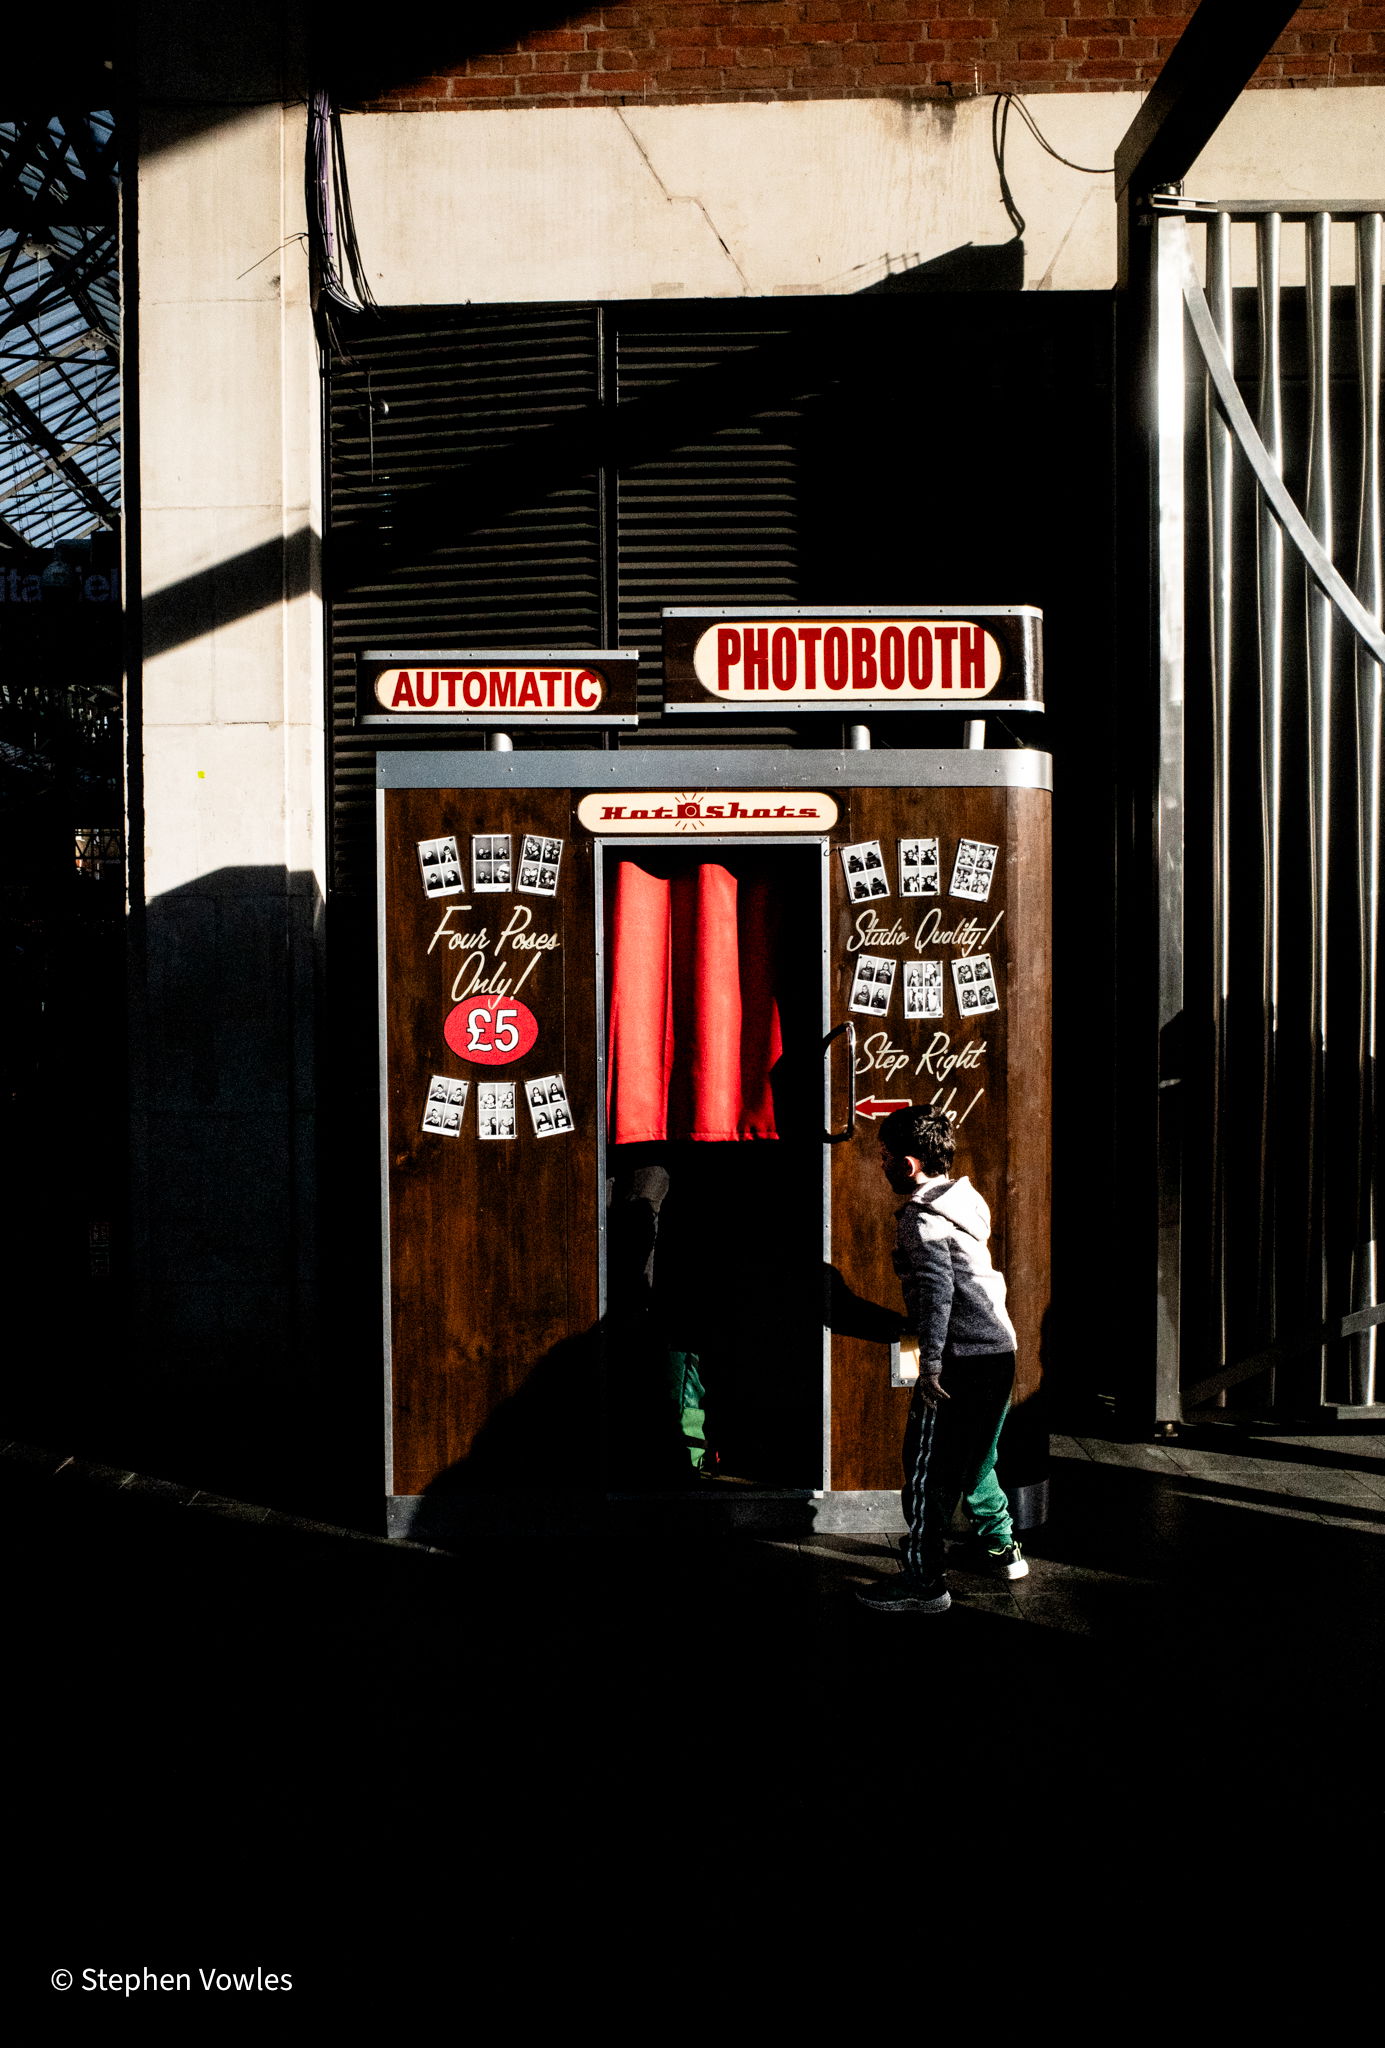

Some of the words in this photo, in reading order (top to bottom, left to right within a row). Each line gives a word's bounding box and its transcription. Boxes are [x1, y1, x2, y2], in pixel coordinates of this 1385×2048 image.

[716, 625, 986, 691] PHOTOBOOTH
[391, 671, 598, 708] AUTOMATIC
[600, 806, 674, 820] Hot
[705, 802, 820, 818] Shots
[427, 905, 490, 955] Four
[494, 905, 560, 956] Poses
[847, 909, 910, 952] Studio
[914, 908, 1004, 957] Quality!
[451, 951, 542, 1010] Only!
[466, 1007, 519, 1052] £5
[855, 1032, 909, 1081] Step
[915, 1032, 987, 1081] Right
